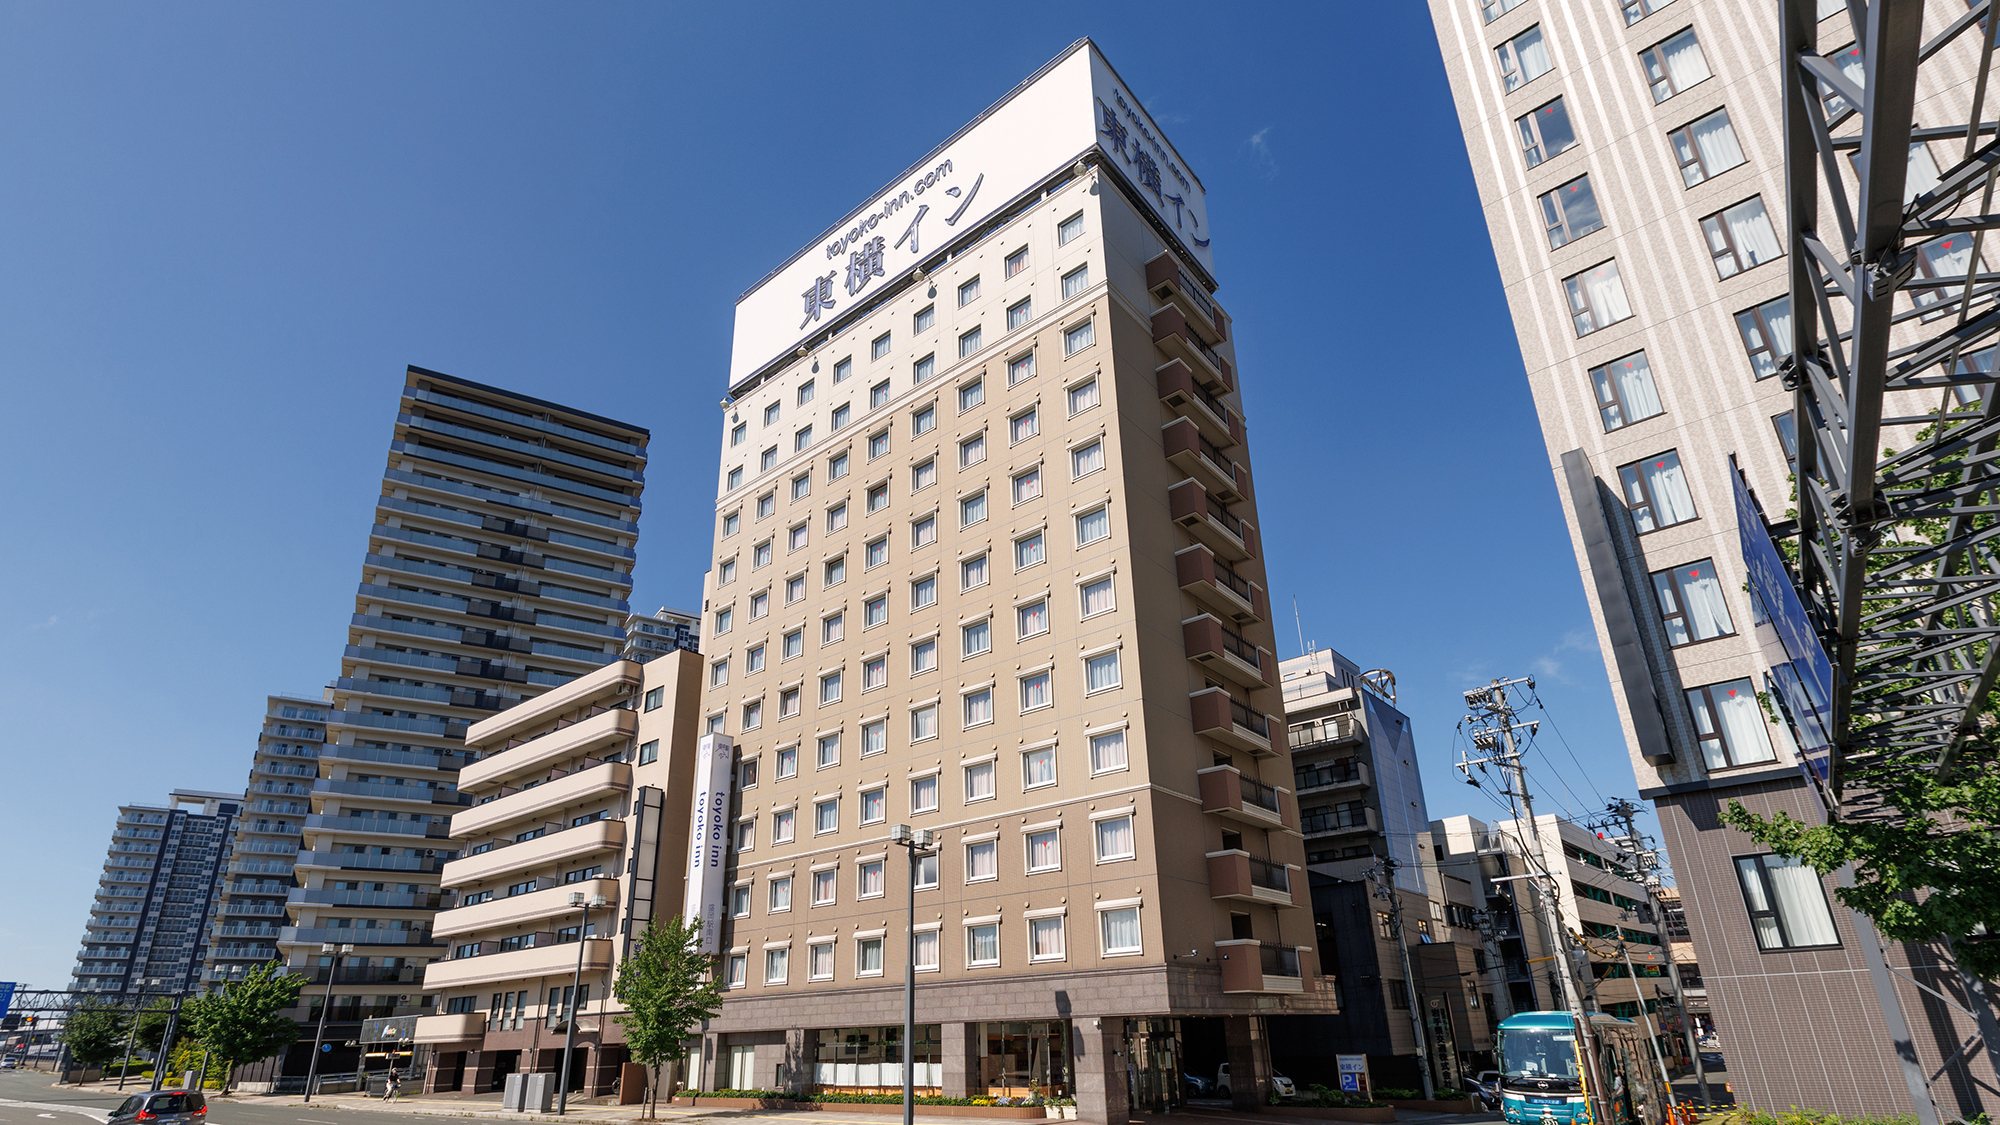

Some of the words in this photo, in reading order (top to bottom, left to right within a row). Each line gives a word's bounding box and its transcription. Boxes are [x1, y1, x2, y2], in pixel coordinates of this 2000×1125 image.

[1113, 88, 1191, 194] toyoko-inn.com
[1096, 97, 1210, 247] 東横イン
[826, 159, 952, 260] toyoko-inn.com
[800, 173, 984, 330] 東横イン
[695, 791, 707, 841] toyoko
[712, 791, 725, 841] toyoko
[694, 845, 703, 868] inn
[711, 845, 722, 868] inn
[1342, 1074, 1353, 1086] P
